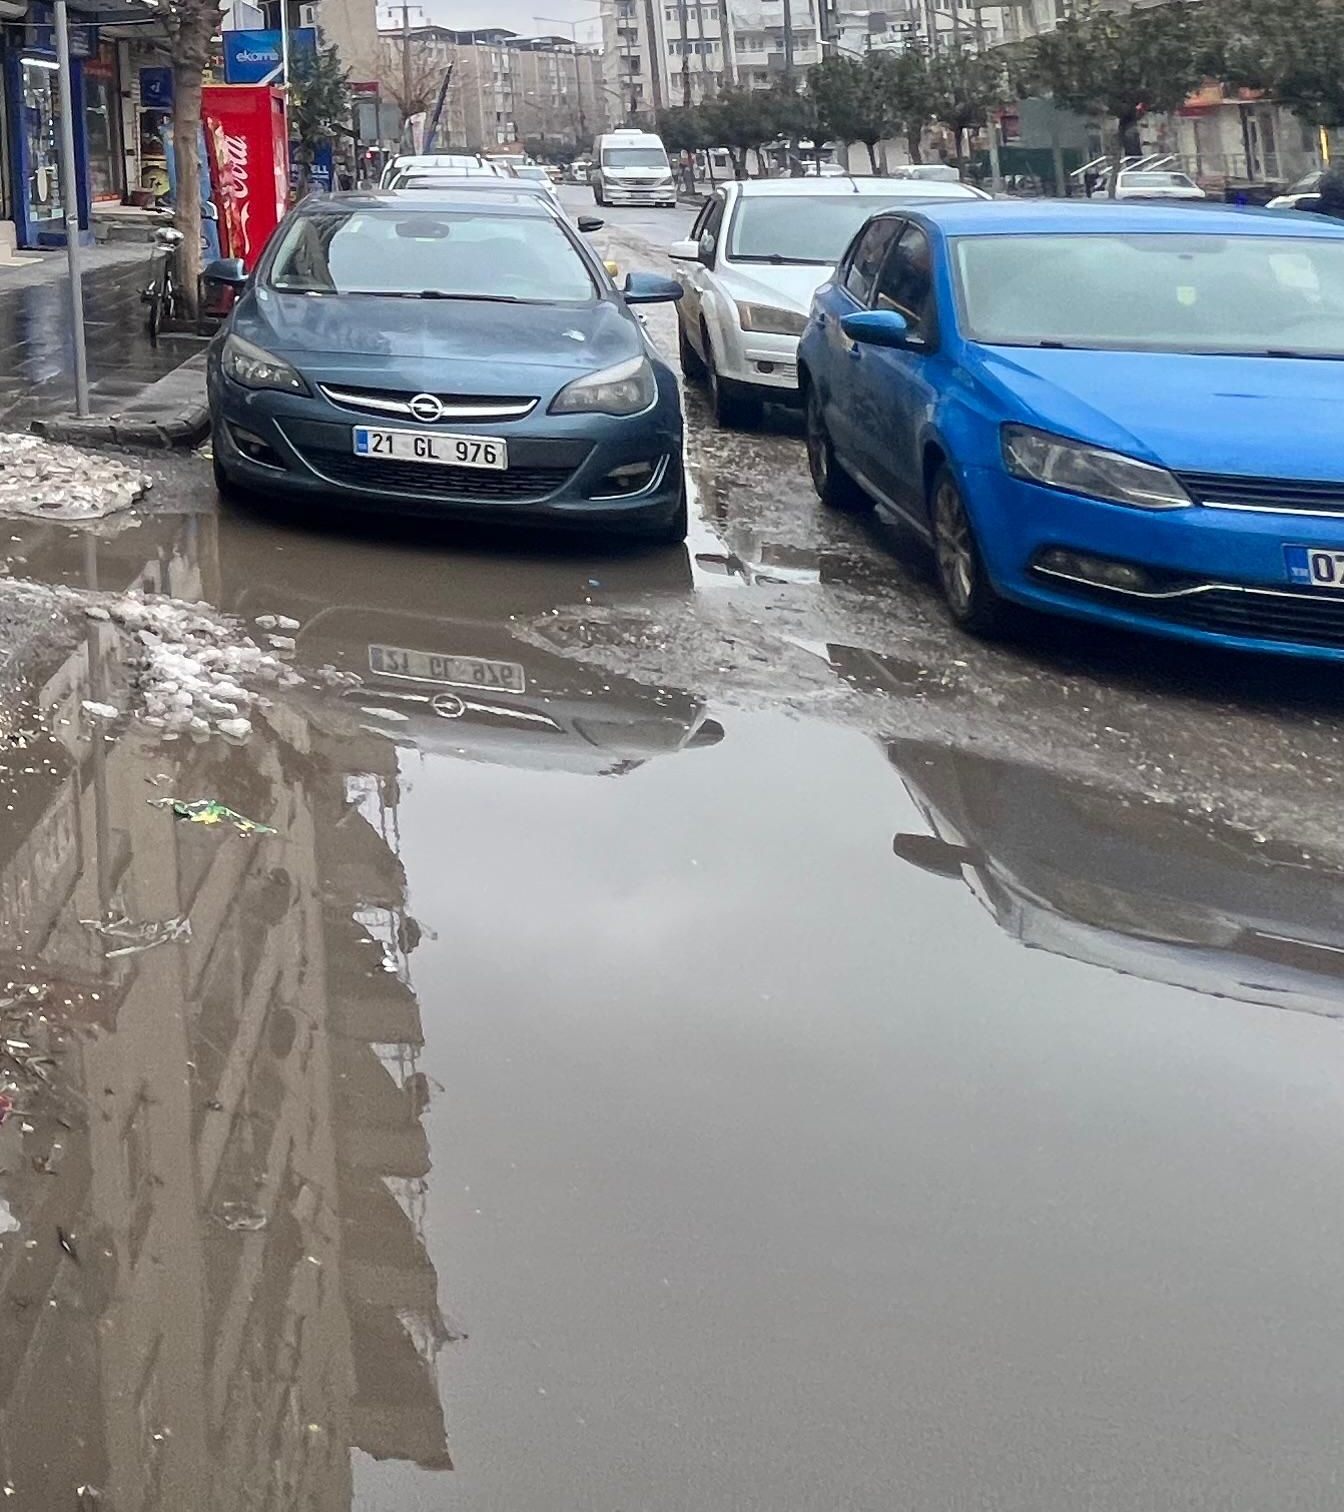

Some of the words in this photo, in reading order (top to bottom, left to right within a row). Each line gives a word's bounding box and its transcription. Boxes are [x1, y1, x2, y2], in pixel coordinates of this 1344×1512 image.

[372, 433, 394, 454] 21
[414, 437, 440, 460] GL
[456, 441, 497, 465] 976
